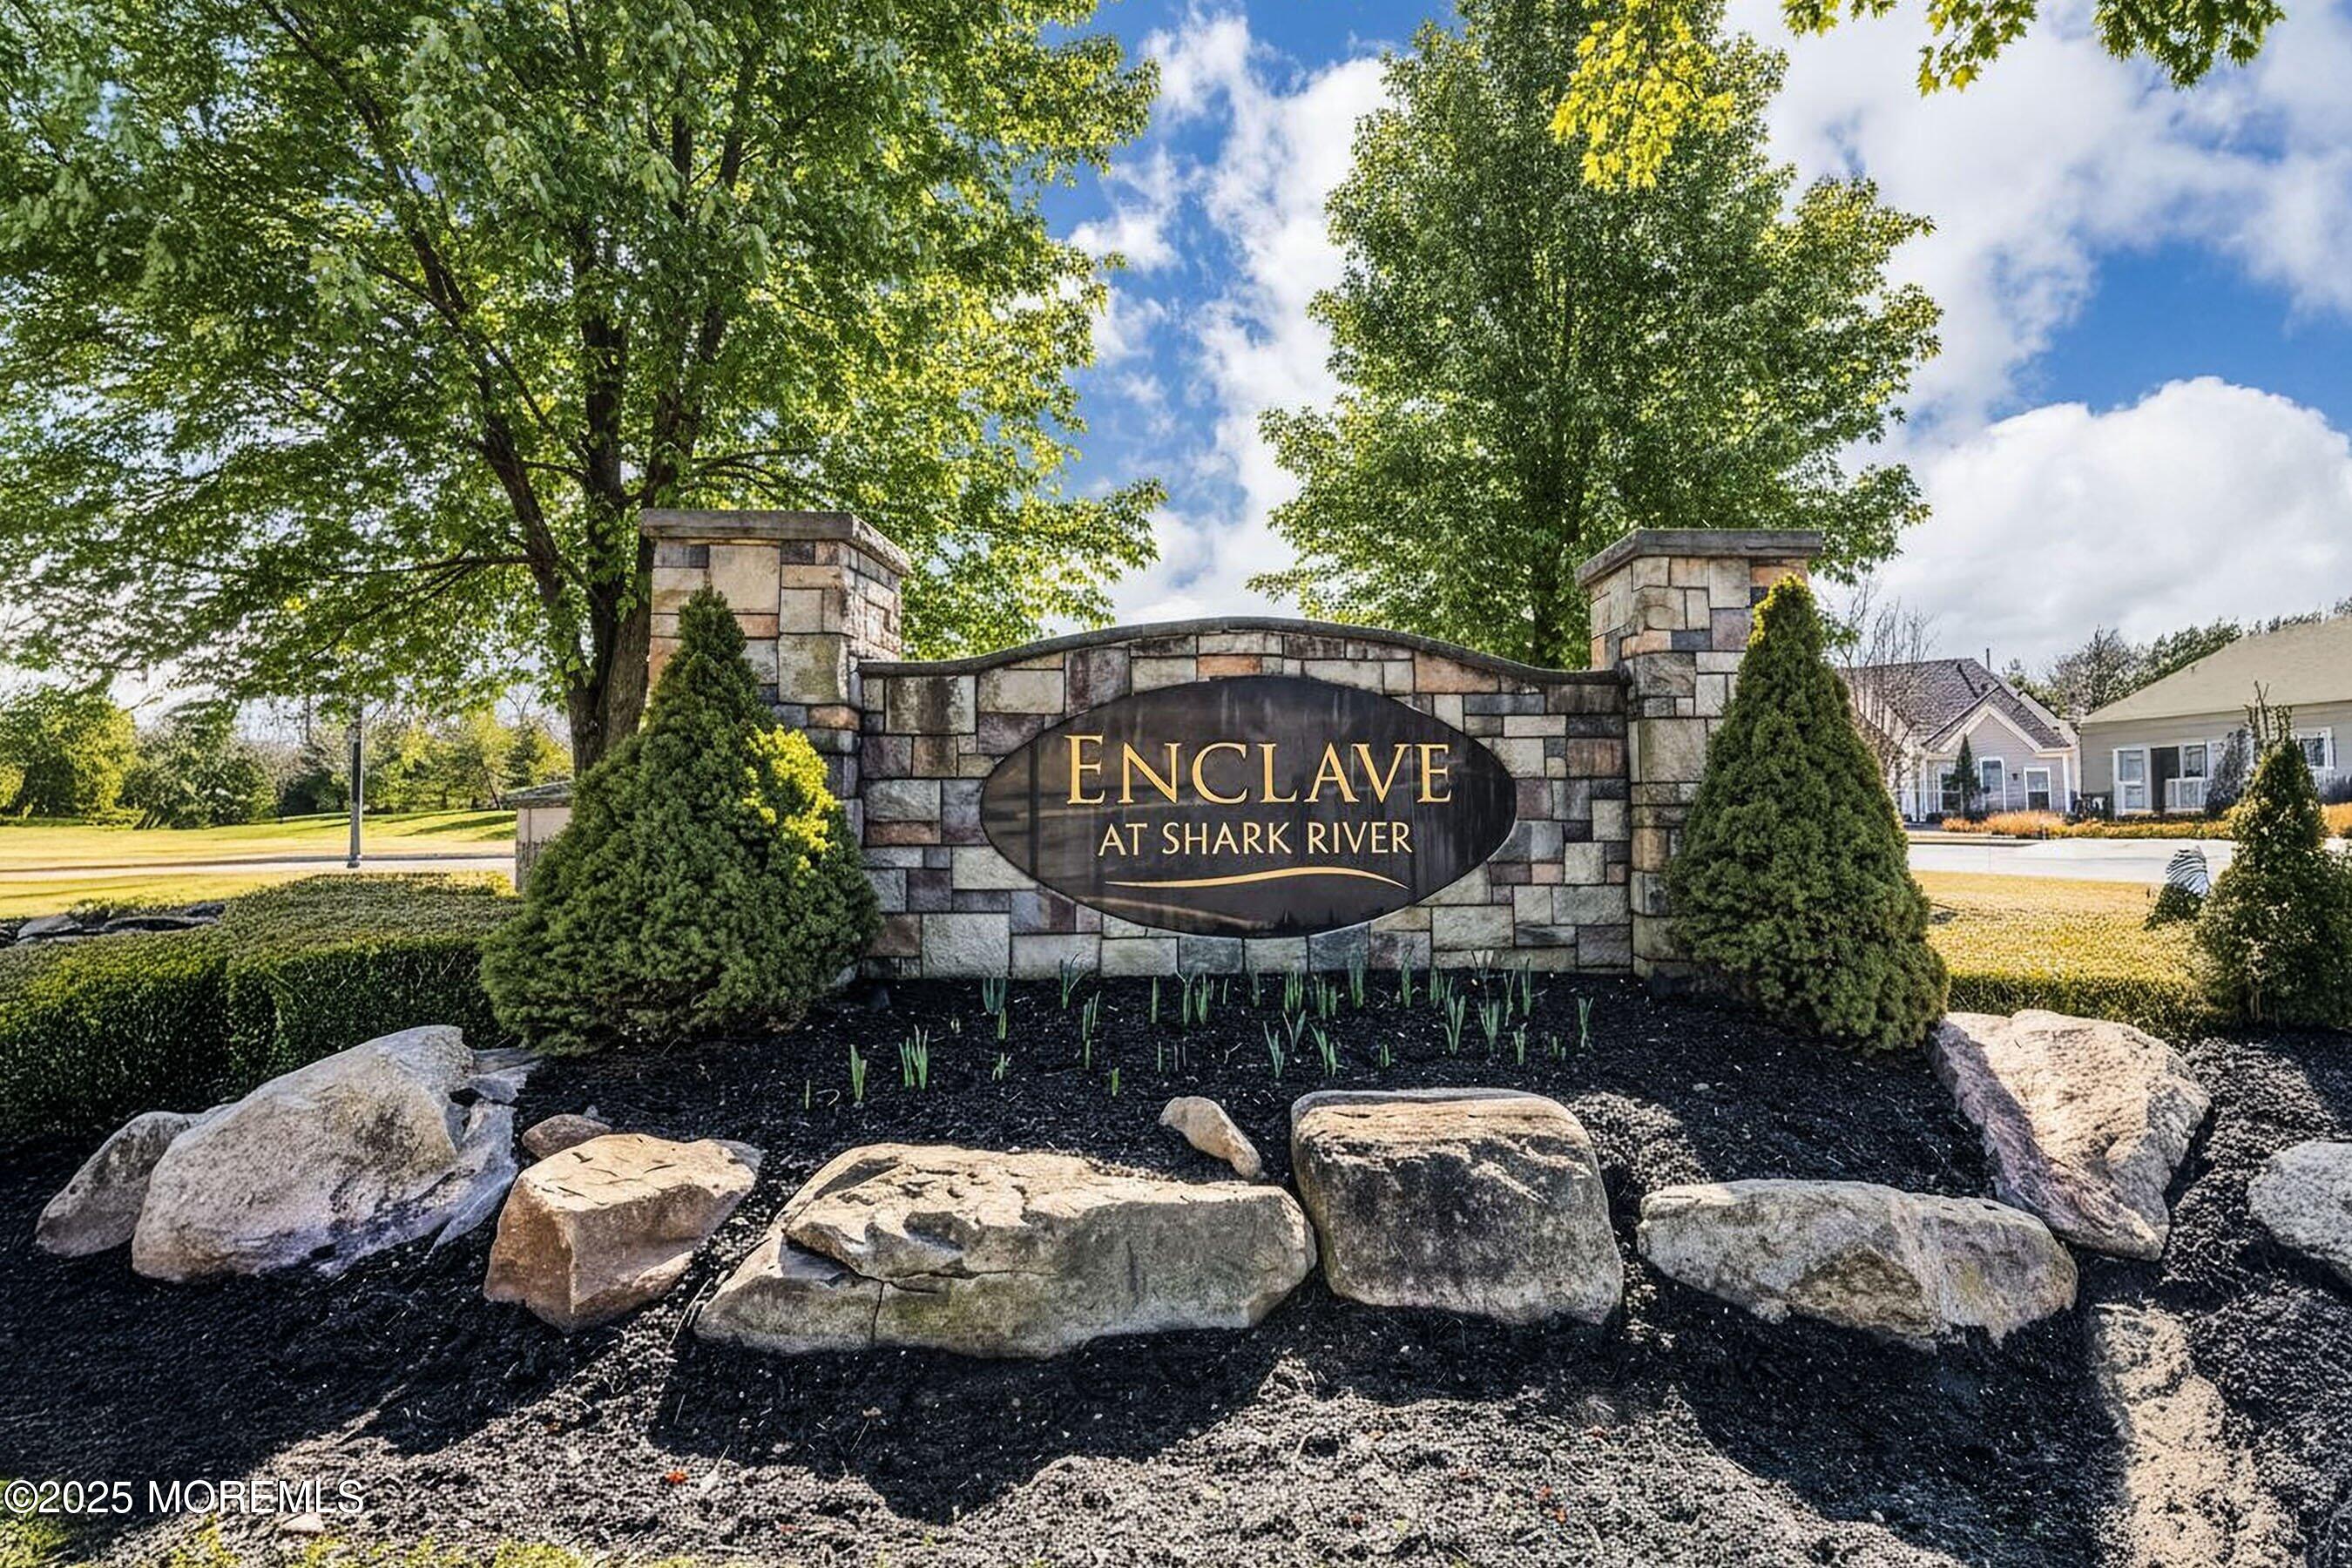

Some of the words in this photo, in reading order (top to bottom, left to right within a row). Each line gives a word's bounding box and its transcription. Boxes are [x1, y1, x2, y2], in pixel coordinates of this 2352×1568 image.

[1064, 733, 1453, 806] ENCLAVE
[1098, 821, 1148, 857] AT
[1161, 821, 1294, 855] SHARK
[1307, 821, 1413, 854] RIVER
